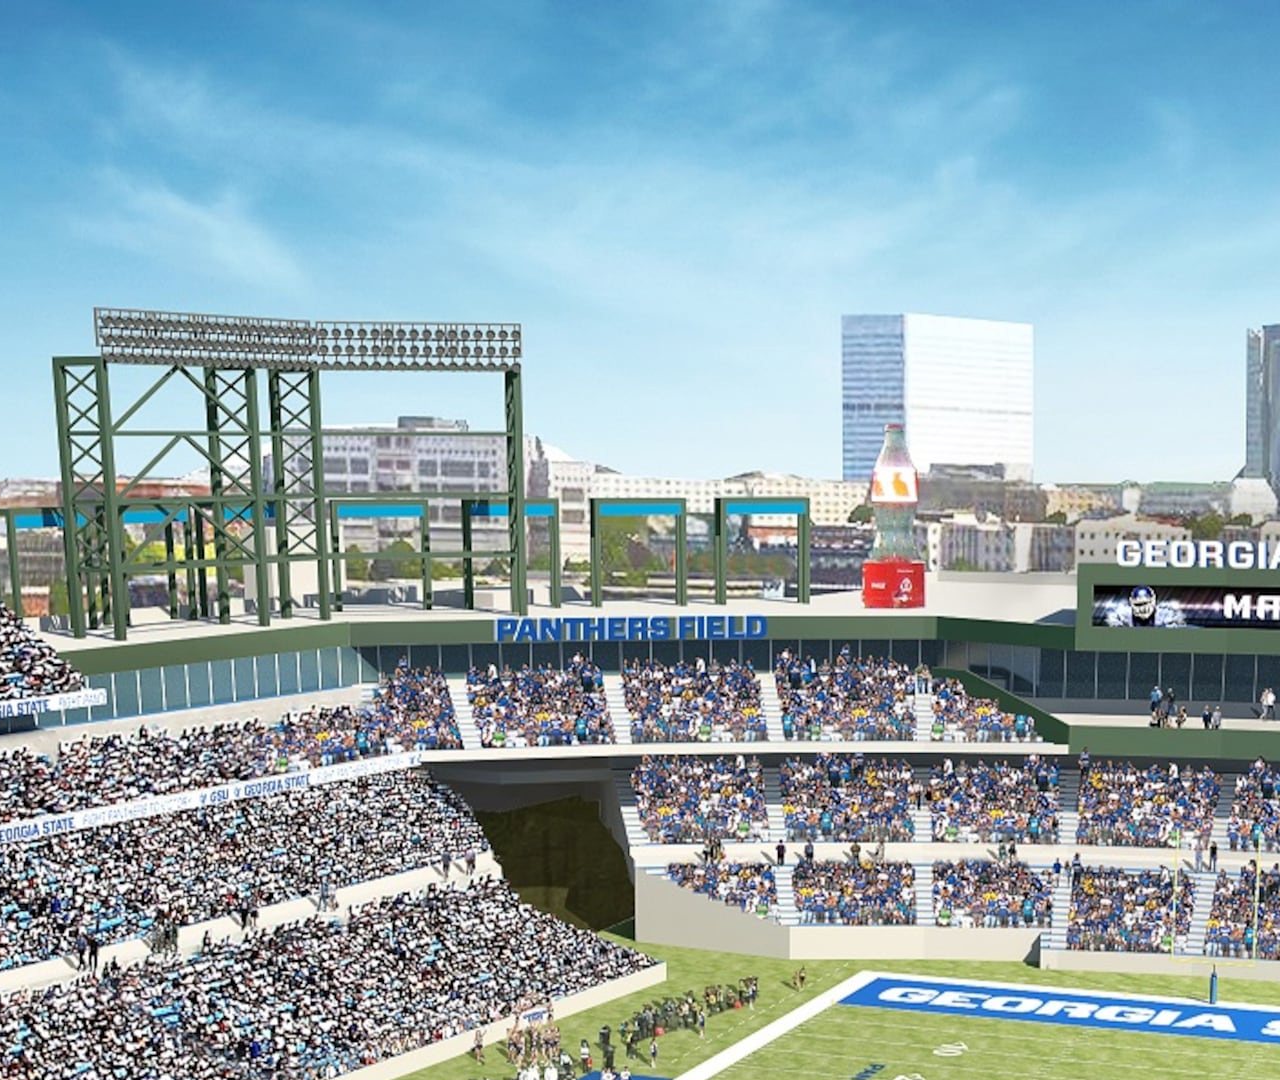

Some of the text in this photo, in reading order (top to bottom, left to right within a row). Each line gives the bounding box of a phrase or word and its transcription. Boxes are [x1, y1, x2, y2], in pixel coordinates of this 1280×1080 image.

[496, 615, 768, 642] PANTHERS FIELD
[42, 817, 75, 835] STATE
[876, 984, 1237, 1033] GEORGIA
